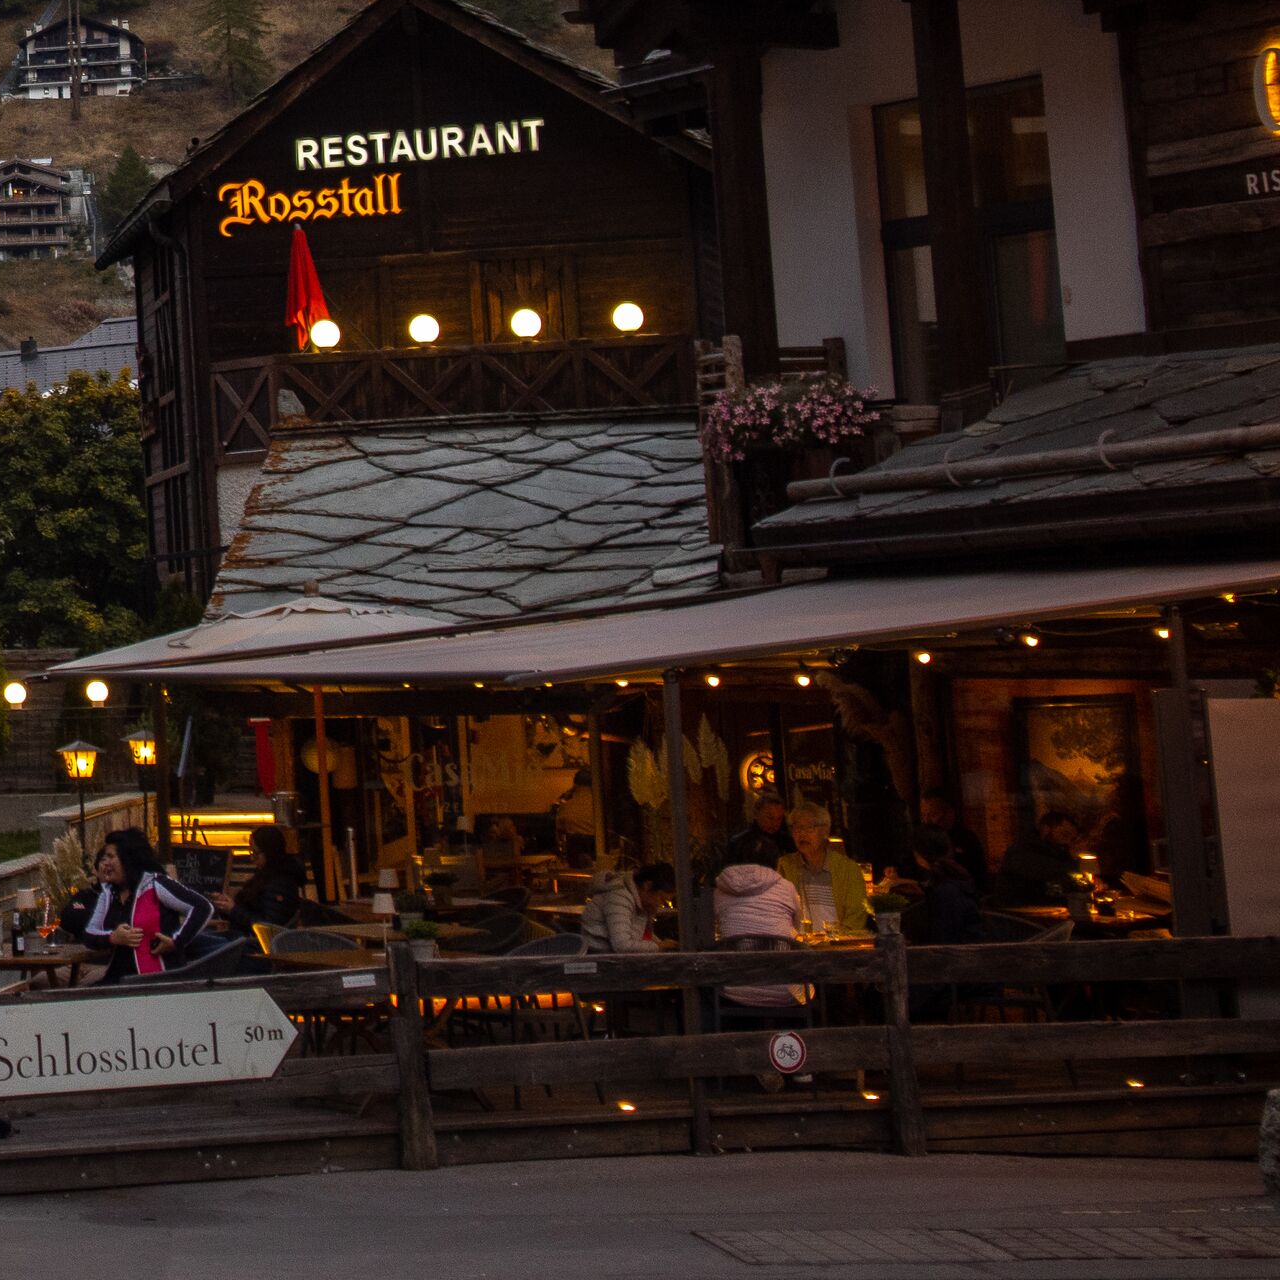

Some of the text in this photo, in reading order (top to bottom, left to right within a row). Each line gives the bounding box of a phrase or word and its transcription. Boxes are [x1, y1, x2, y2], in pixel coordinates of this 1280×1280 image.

[295, 118, 545, 170] RESTAURANT
[218, 173, 403, 237] Rosstall
[244, 1025, 265, 1043] 50
[268, 1028, 284, 1041] m
